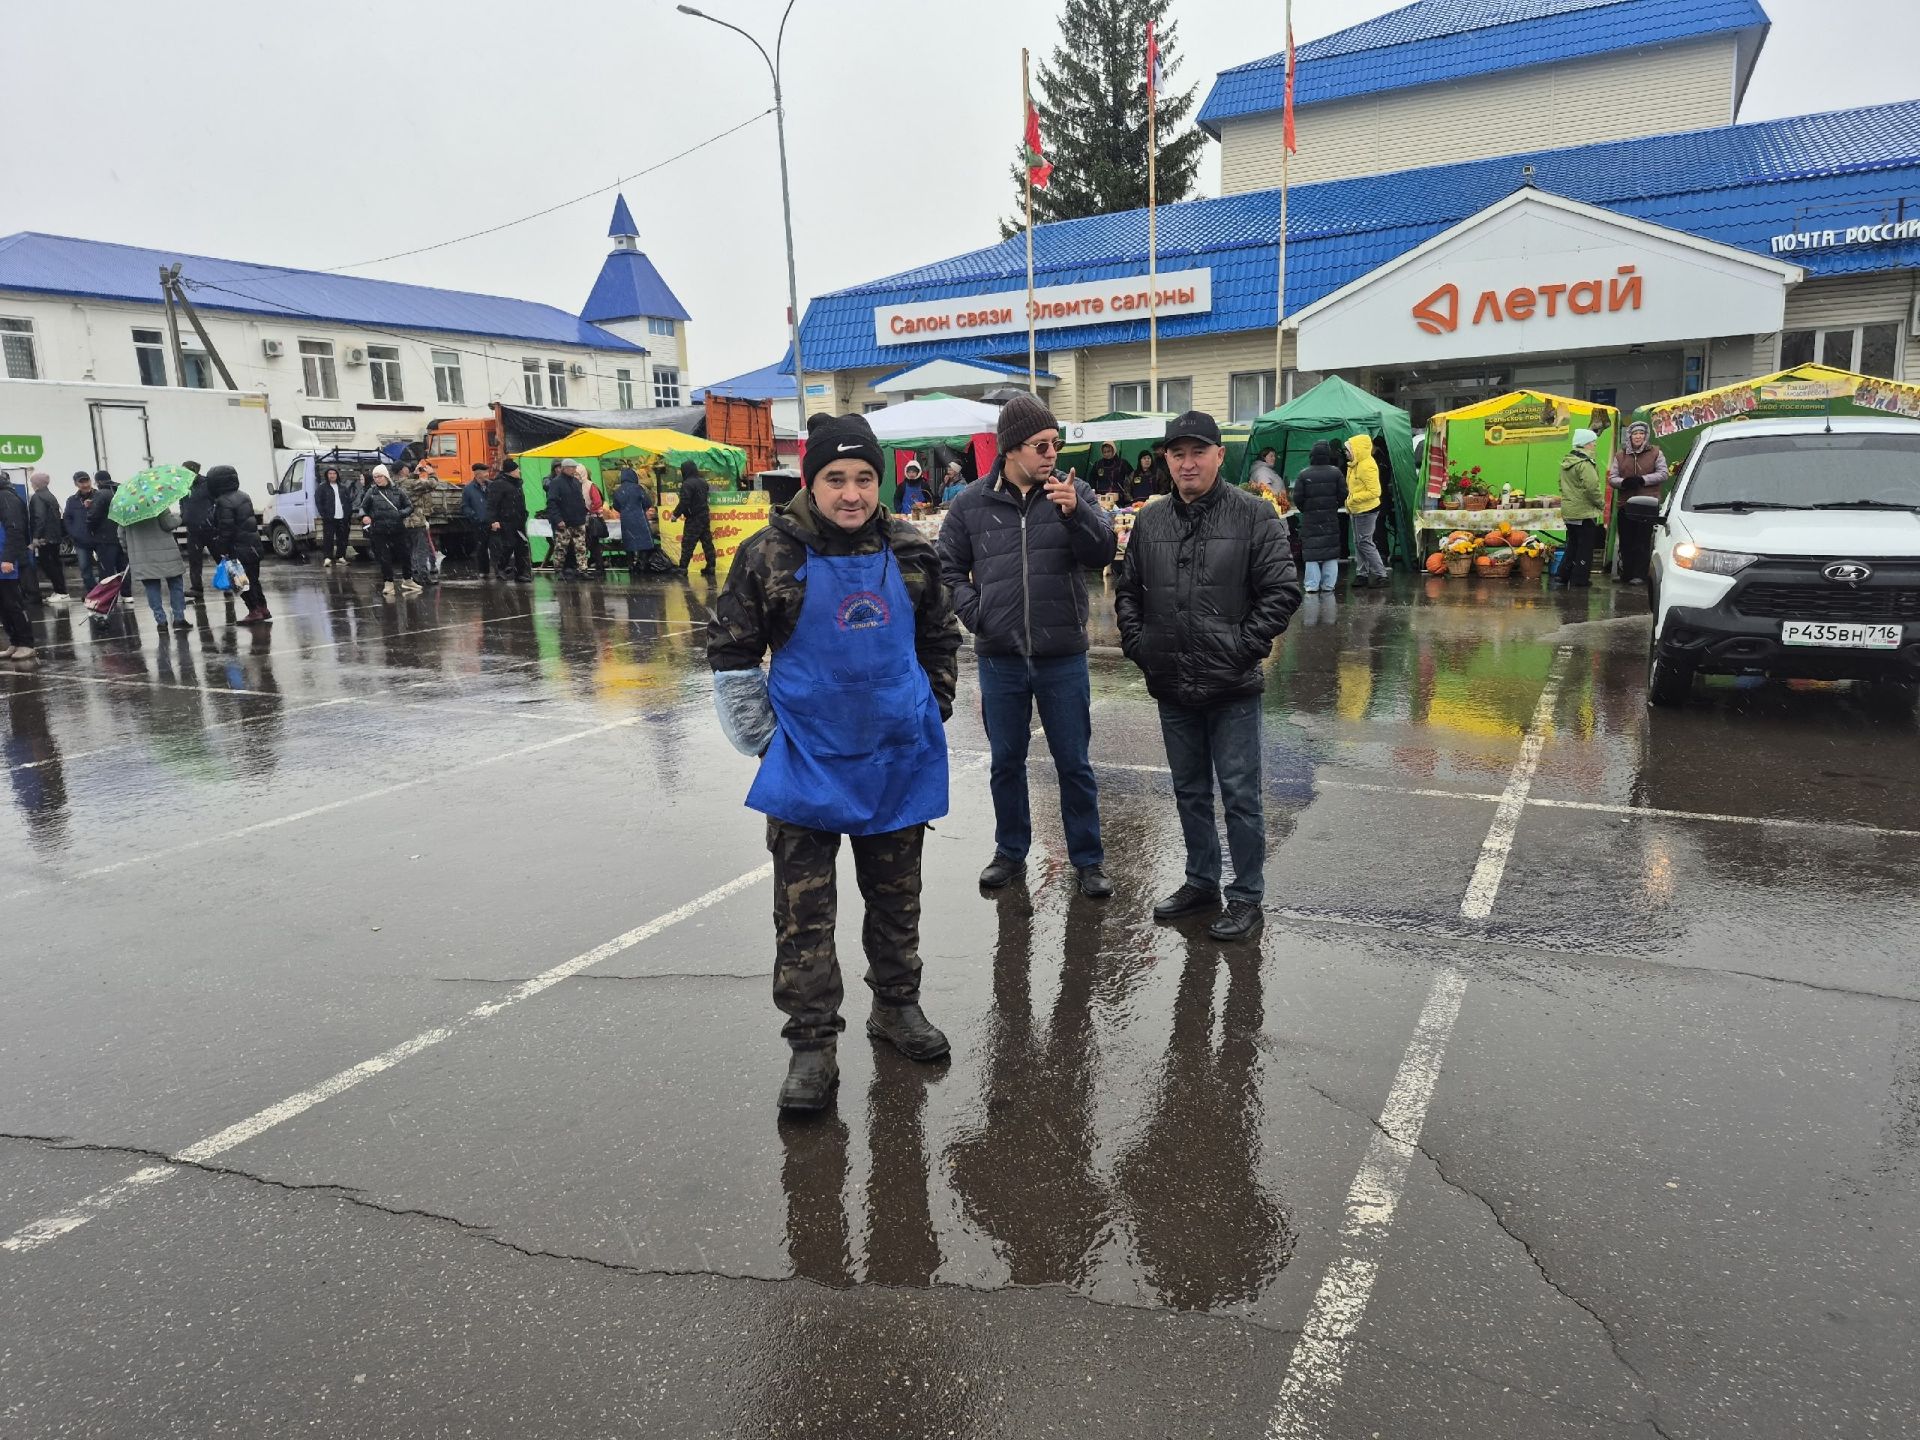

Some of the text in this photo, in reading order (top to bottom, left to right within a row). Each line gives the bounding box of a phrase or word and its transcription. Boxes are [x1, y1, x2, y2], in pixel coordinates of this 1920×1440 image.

[1771, 219, 1920, 252] ПОЧТА РОССИИ
[890, 313, 950, 334] Салон
[956, 309, 1012, 328] связи
[1111, 286, 1194, 311] салоны
[1473, 265, 1642, 324] летай
[0, 440, 36, 455] d.ru
